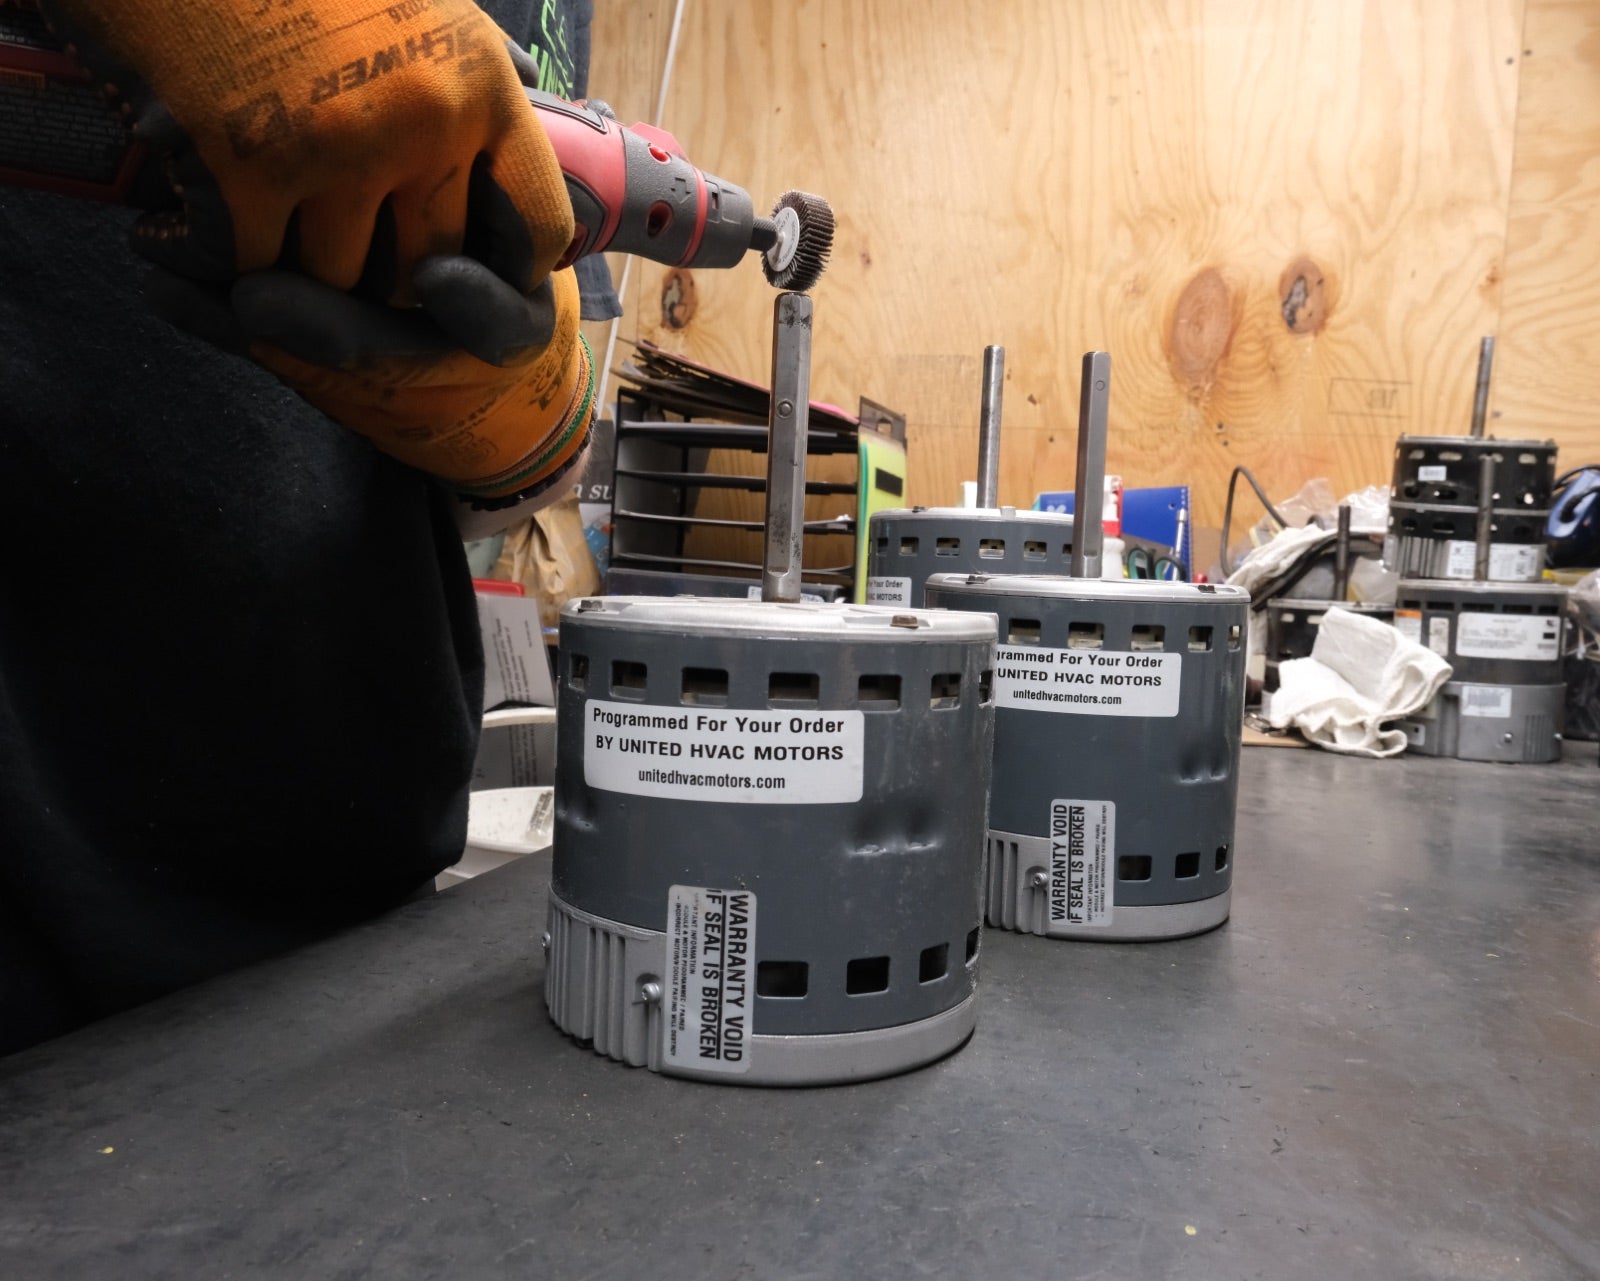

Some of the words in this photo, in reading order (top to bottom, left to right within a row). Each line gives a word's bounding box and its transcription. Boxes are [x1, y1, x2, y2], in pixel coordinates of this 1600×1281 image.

[310, 21, 485, 105] SCHWER
[885, 579, 903, 588] Order
[876, 593, 903, 602] MOTORS
[1060, 653, 1083, 665] For
[1088, 654, 1121, 667] Your
[1126, 656, 1163, 668] Order
[997, 668, 1048, 682] UNITED
[1054, 672, 1095, 684] HVAC
[1100, 675, 1162, 687] MOTORS
[1013, 689, 1122, 705] unitedhvacmotors.com
[593, 707, 688, 731] Programmed
[696, 716, 727, 732] For
[735, 717, 782, 733] Your
[789, 717, 845, 733] Order
[596, 735, 614, 750] BY
[619, 738, 682, 757] UNITED
[690, 743, 745, 760] HVAC
[754, 745, 844, 761] MOTORS
[638, 768, 786, 789] unitedhvacmotors.com
[1053, 804, 1067, 837] VOID
[1072, 806, 1085, 856] BROKEN
[1071, 861, 1084, 873] IS
[1051, 841, 1066, 921] WARRANTY
[1071, 877, 1083, 908] SEAL
[705, 889, 723, 905] IF
[1070, 912, 1083, 924] IF
[704, 911, 722, 955] SEAL
[681, 936, 689, 958] MOTOR
[689, 929, 698, 975] INFORMATION
[725, 894, 749, 1009] WARRANTY
[679, 959, 688, 1003] PROGRAMMED
[703, 962, 719, 980] IS
[678, 1008, 686, 1031] PAIRED
[699, 986, 718, 1059] BROKEN
[723, 1016, 744, 1062] VOID
